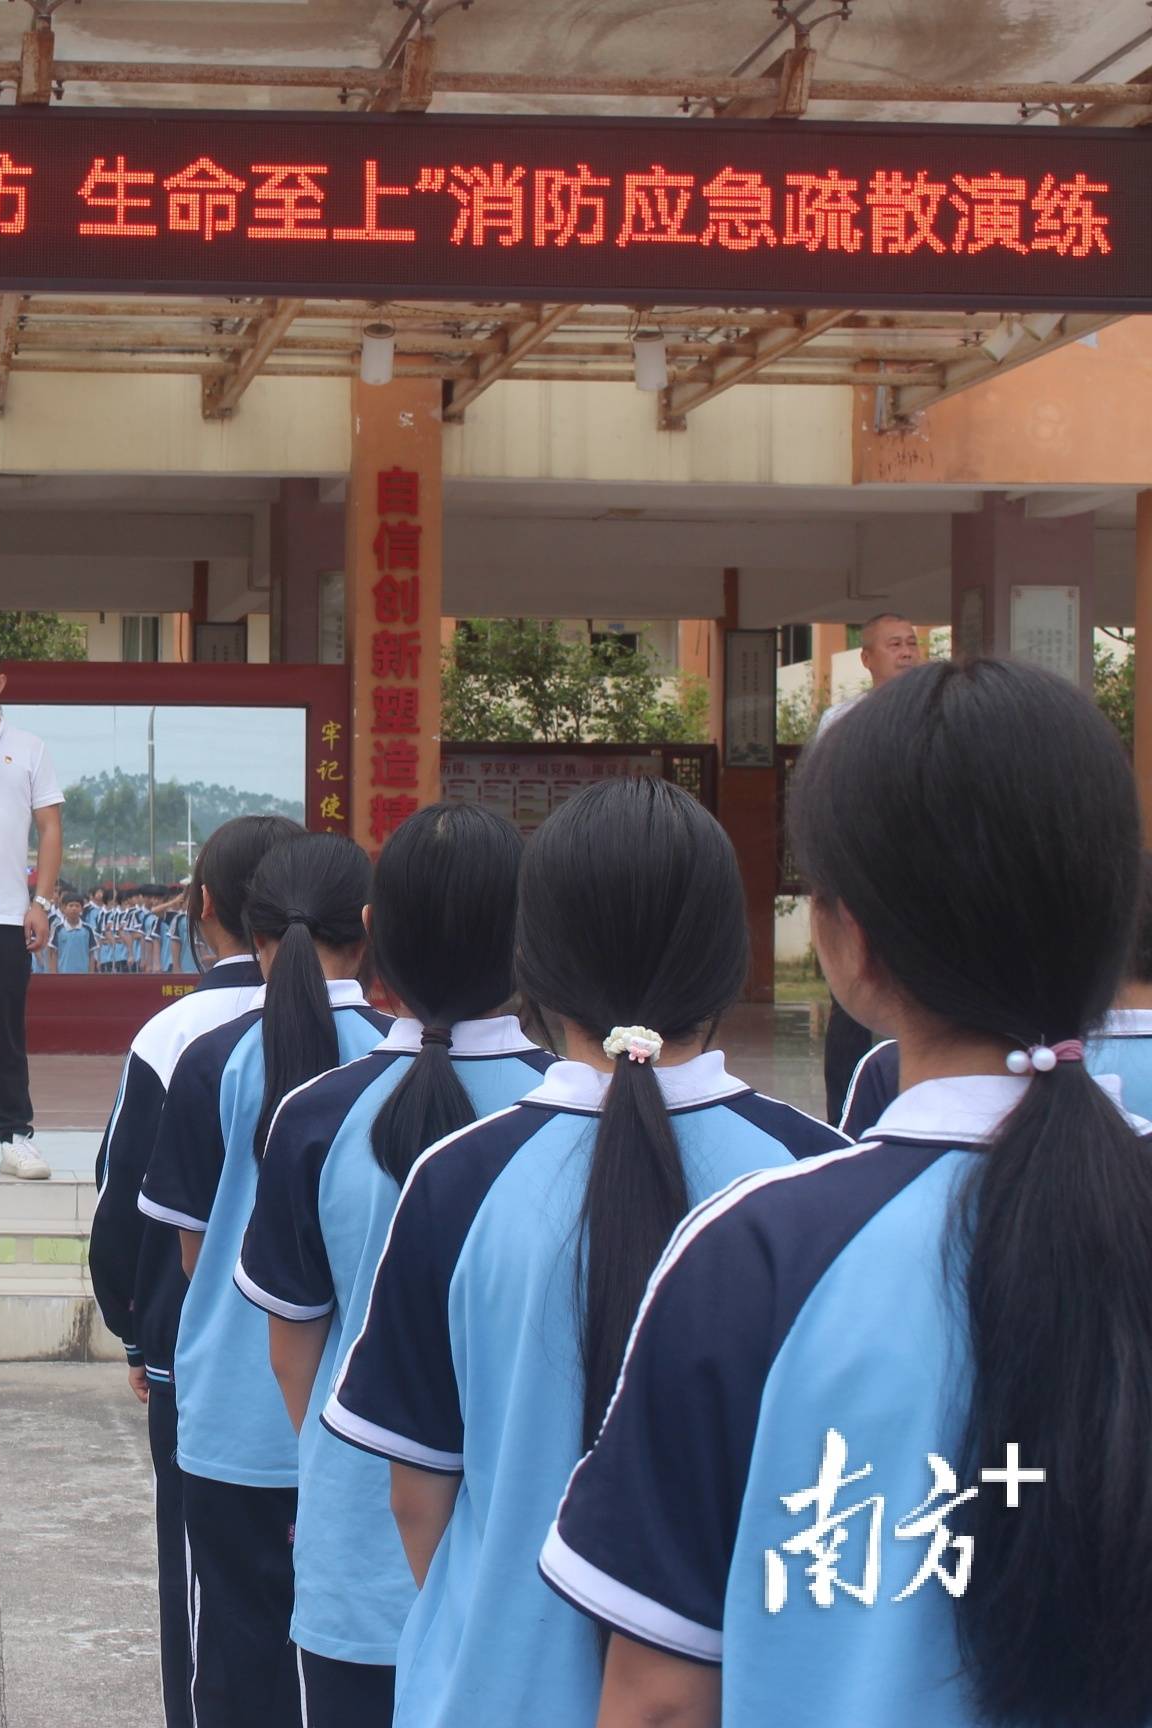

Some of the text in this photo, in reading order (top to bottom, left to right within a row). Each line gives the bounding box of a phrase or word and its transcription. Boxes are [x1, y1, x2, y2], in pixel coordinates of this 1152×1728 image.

[77, 155, 1113, 257] 生命至上”消防应急疏散演练
[370, 466, 422, 862] 自信创新塑造精
[316, 719, 345, 832] 牢记使
